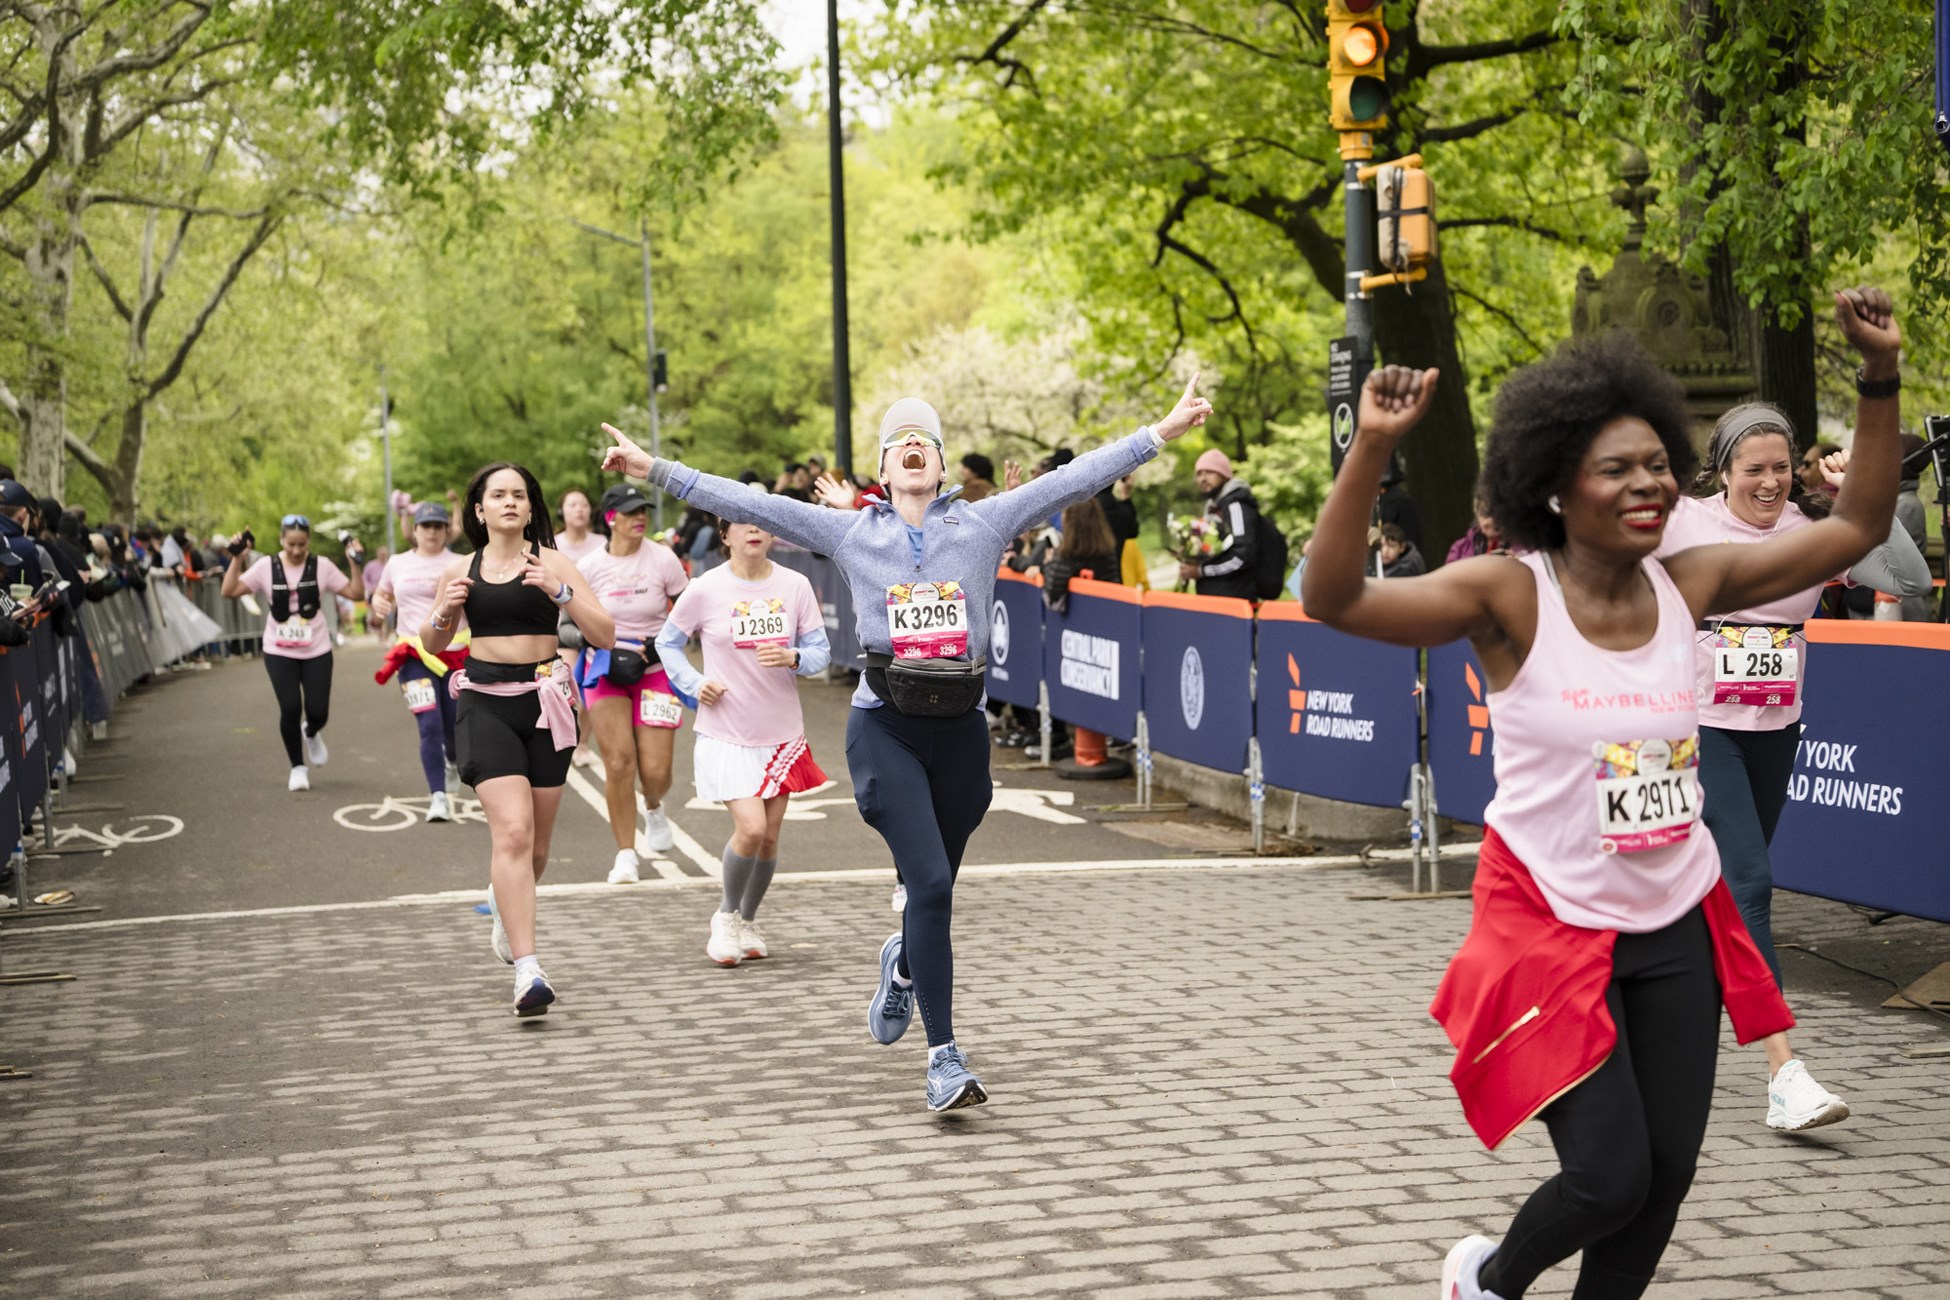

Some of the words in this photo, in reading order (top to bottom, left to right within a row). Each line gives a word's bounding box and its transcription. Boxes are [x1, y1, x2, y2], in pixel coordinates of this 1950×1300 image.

[738, 621, 745, 636] J
[750, 617, 782, 636] 2369
[894, 609, 908, 628] K
[911, 604, 958, 630] 3296
[904, 648, 922, 656] 3296
[940, 646, 957, 655] 3296
[1723, 654, 1734, 674] L
[1746, 653, 1782, 676] 258
[644, 702, 650, 716] L
[652, 702, 678, 720] 2962
[1307, 690, 1329, 711] NEW
[1328, 692, 1354, 714] YORK
[1573, 689, 1696, 711] MAYBELLINE
[1766, 696, 1781, 704] 258
[1306, 714, 1332, 738] ROAD
[1330, 718, 1374, 742] RUNNERS
[1804, 740, 1857, 772] YORK
[1608, 789, 1630, 822] K
[1638, 776, 1690, 822] 2971
[1812, 778, 1904, 816] RUNNERS
